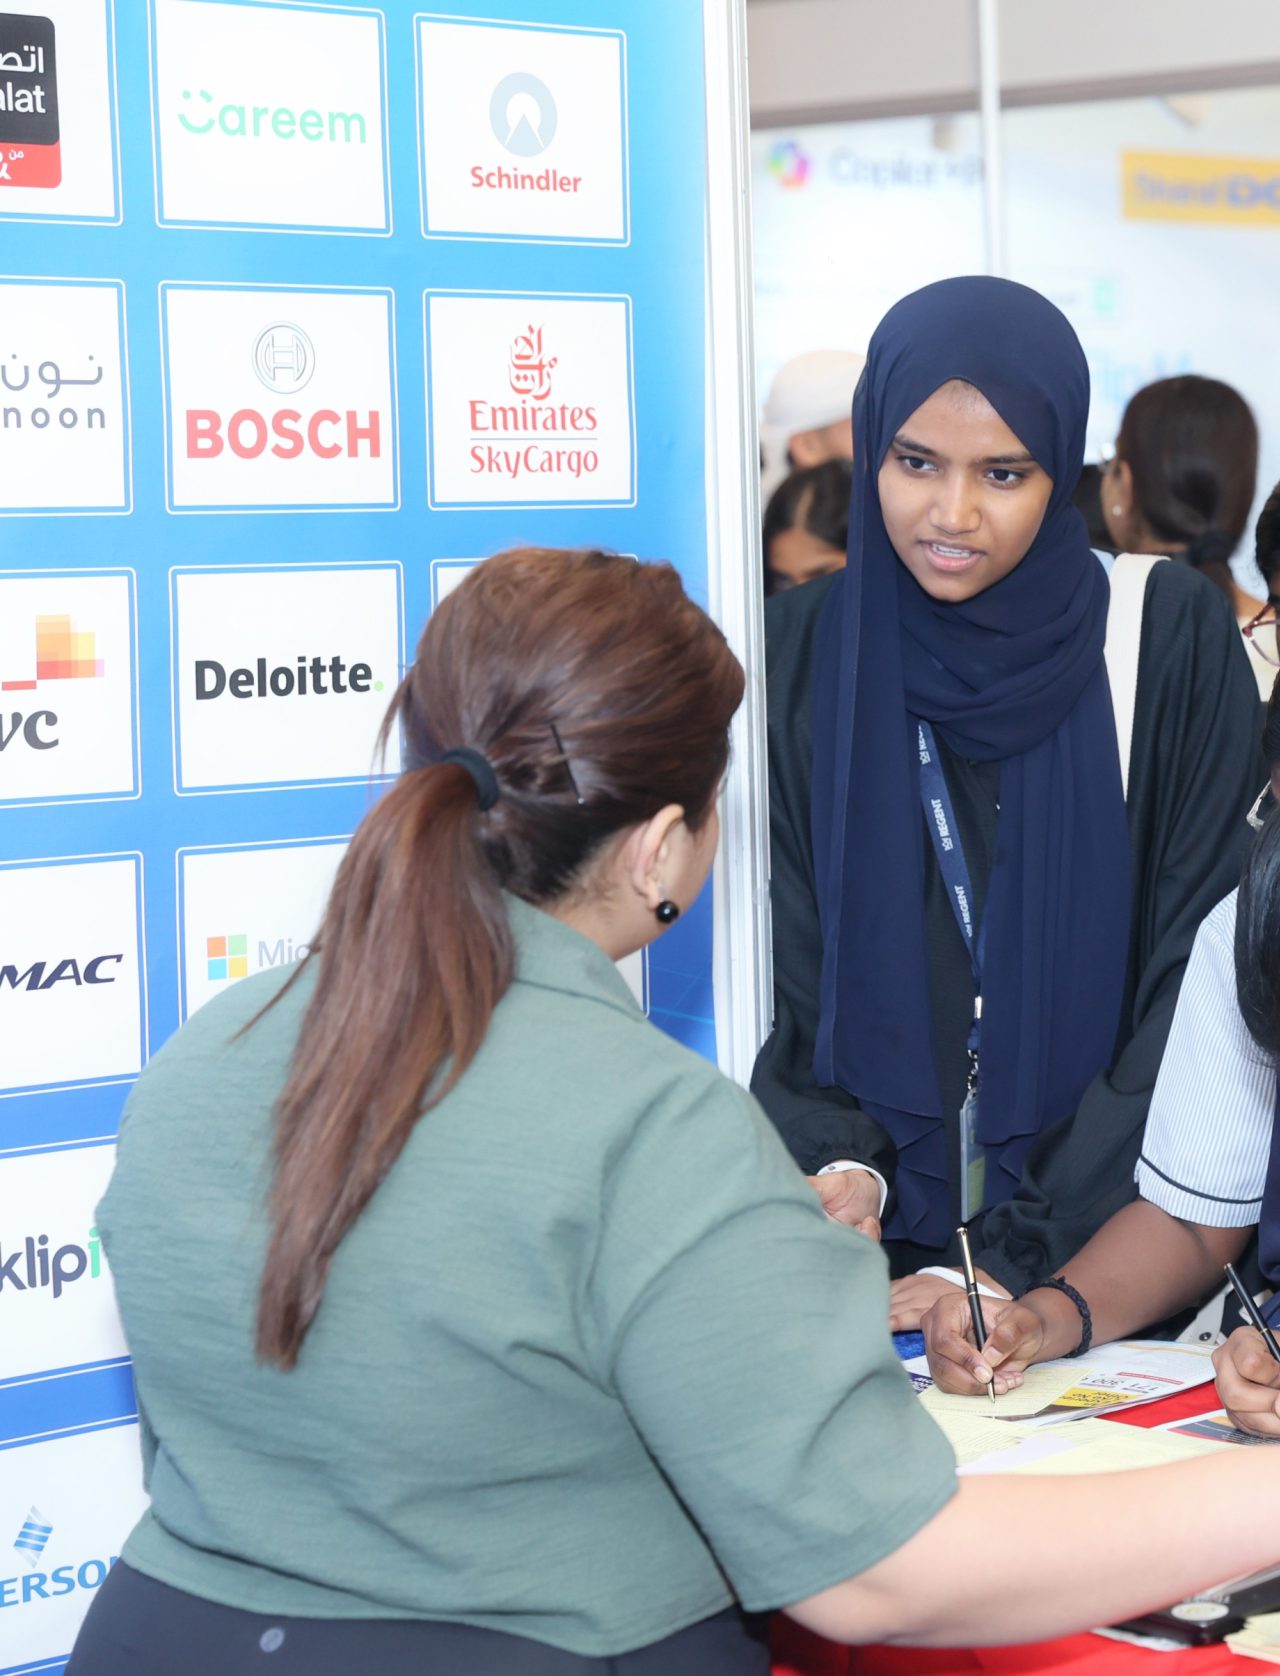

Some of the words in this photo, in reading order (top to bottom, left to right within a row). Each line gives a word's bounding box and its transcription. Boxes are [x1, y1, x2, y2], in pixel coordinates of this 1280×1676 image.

[178, 90, 366, 143] Careem
[471, 166, 582, 192] Schindler
[1, 354, 102, 398] نون
[3, 407, 105, 429] noon
[186, 409, 380, 459] BOSCH
[469, 400, 597, 431] Emirates
[470, 445, 598, 478] SkyCargo
[931, 799, 950, 838] REGENT
[954, 885, 971, 924] REGENT
[0, 1556, 119, 1608] ERSO
